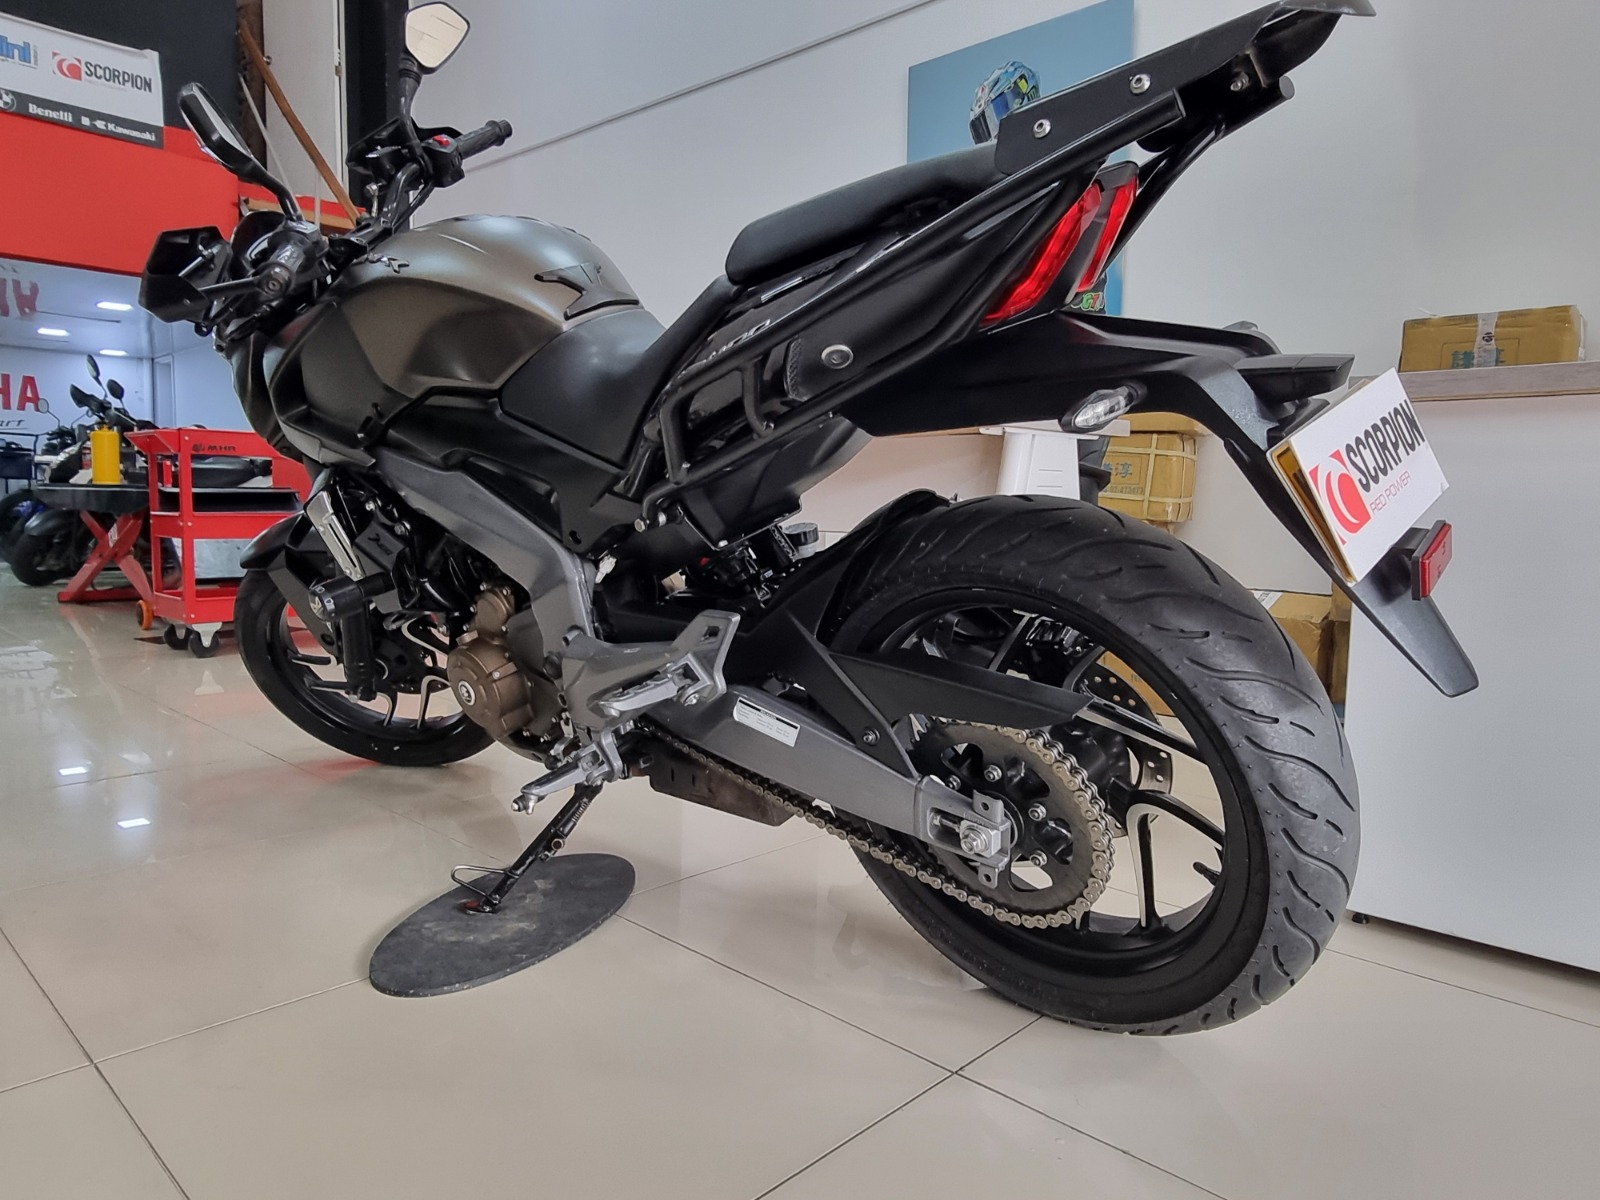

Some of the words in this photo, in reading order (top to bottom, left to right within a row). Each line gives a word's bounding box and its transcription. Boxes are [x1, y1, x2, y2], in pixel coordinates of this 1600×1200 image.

[84, 61, 153, 93] SCORPION
[28, 102, 73, 123] Benelli
[107, 122, 156, 142] Kawasaki
[1345, 399, 1426, 493] SCORPION
[1369, 493, 1387, 515] RED
[1384, 470, 1412, 500] POWER
